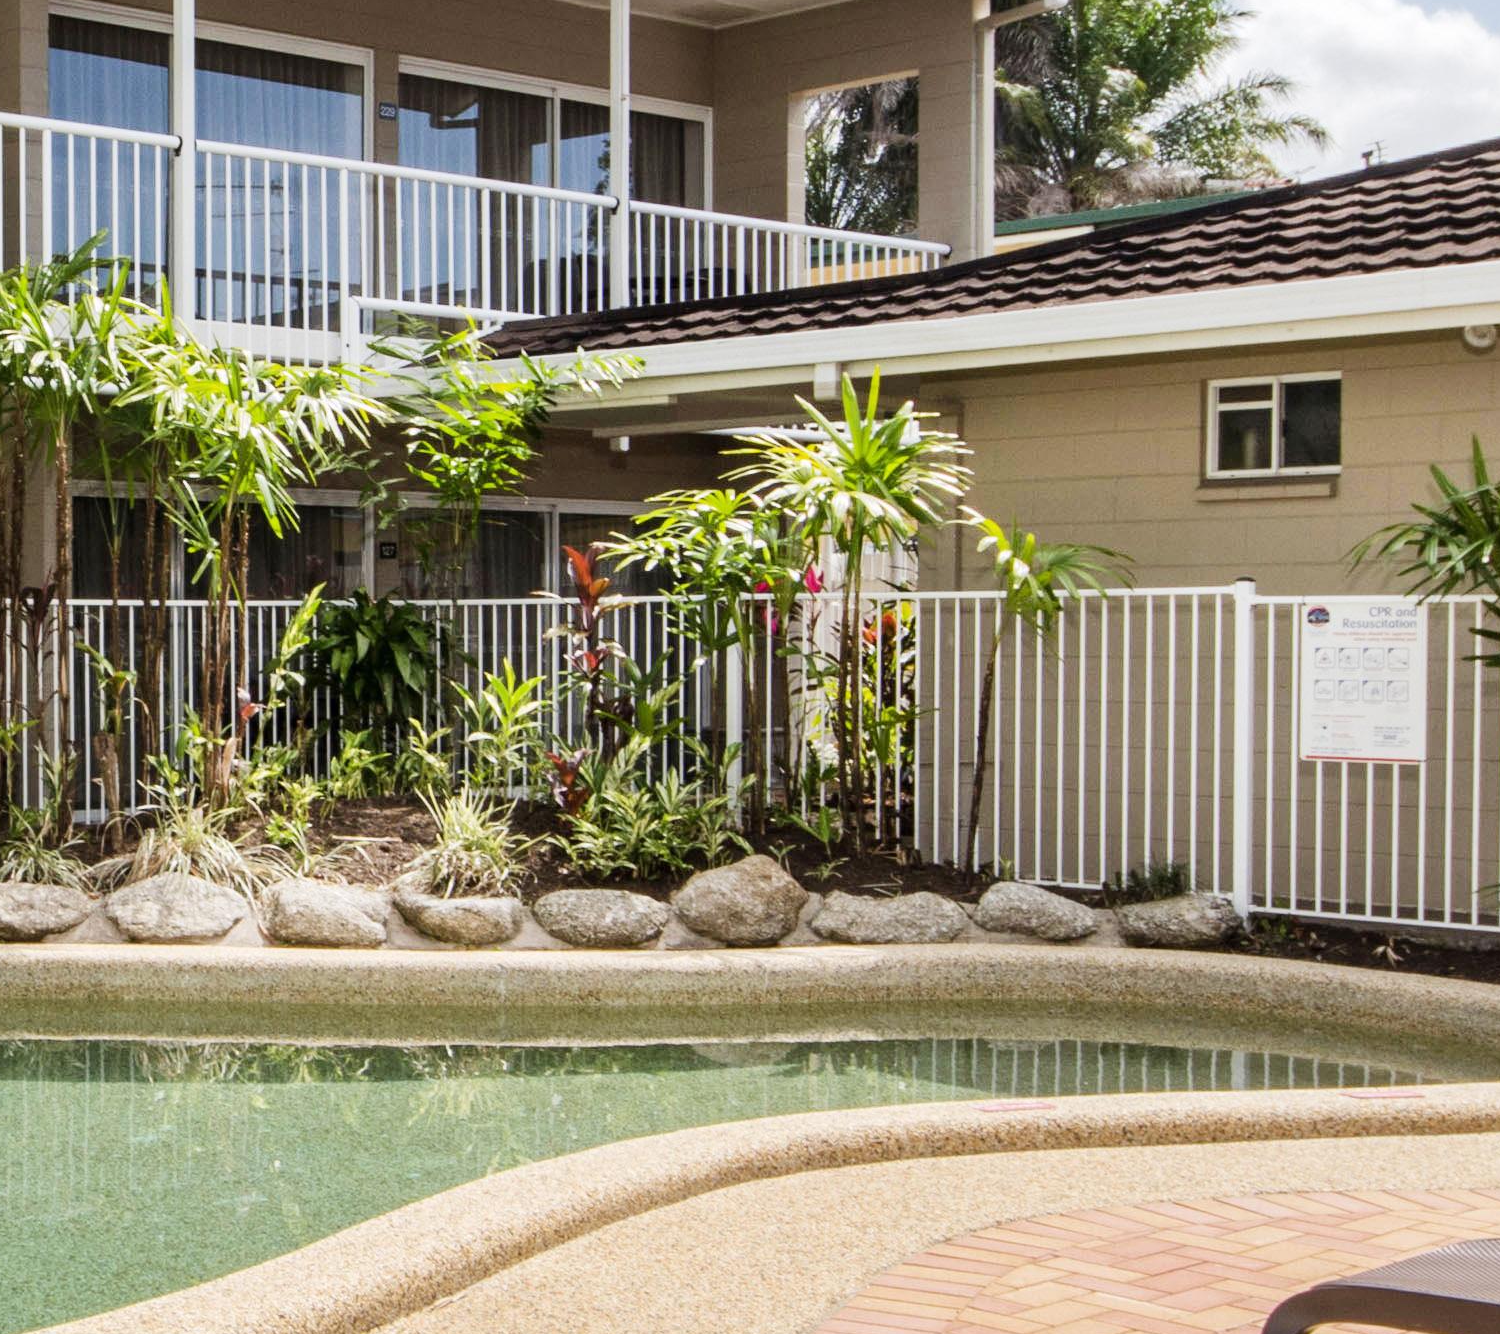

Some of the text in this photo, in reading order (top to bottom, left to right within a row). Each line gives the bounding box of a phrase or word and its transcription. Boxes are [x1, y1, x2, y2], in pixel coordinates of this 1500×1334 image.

[1369, 605, 1417, 617] CPR and
[1342, 618, 1418, 629] Resuscitation
